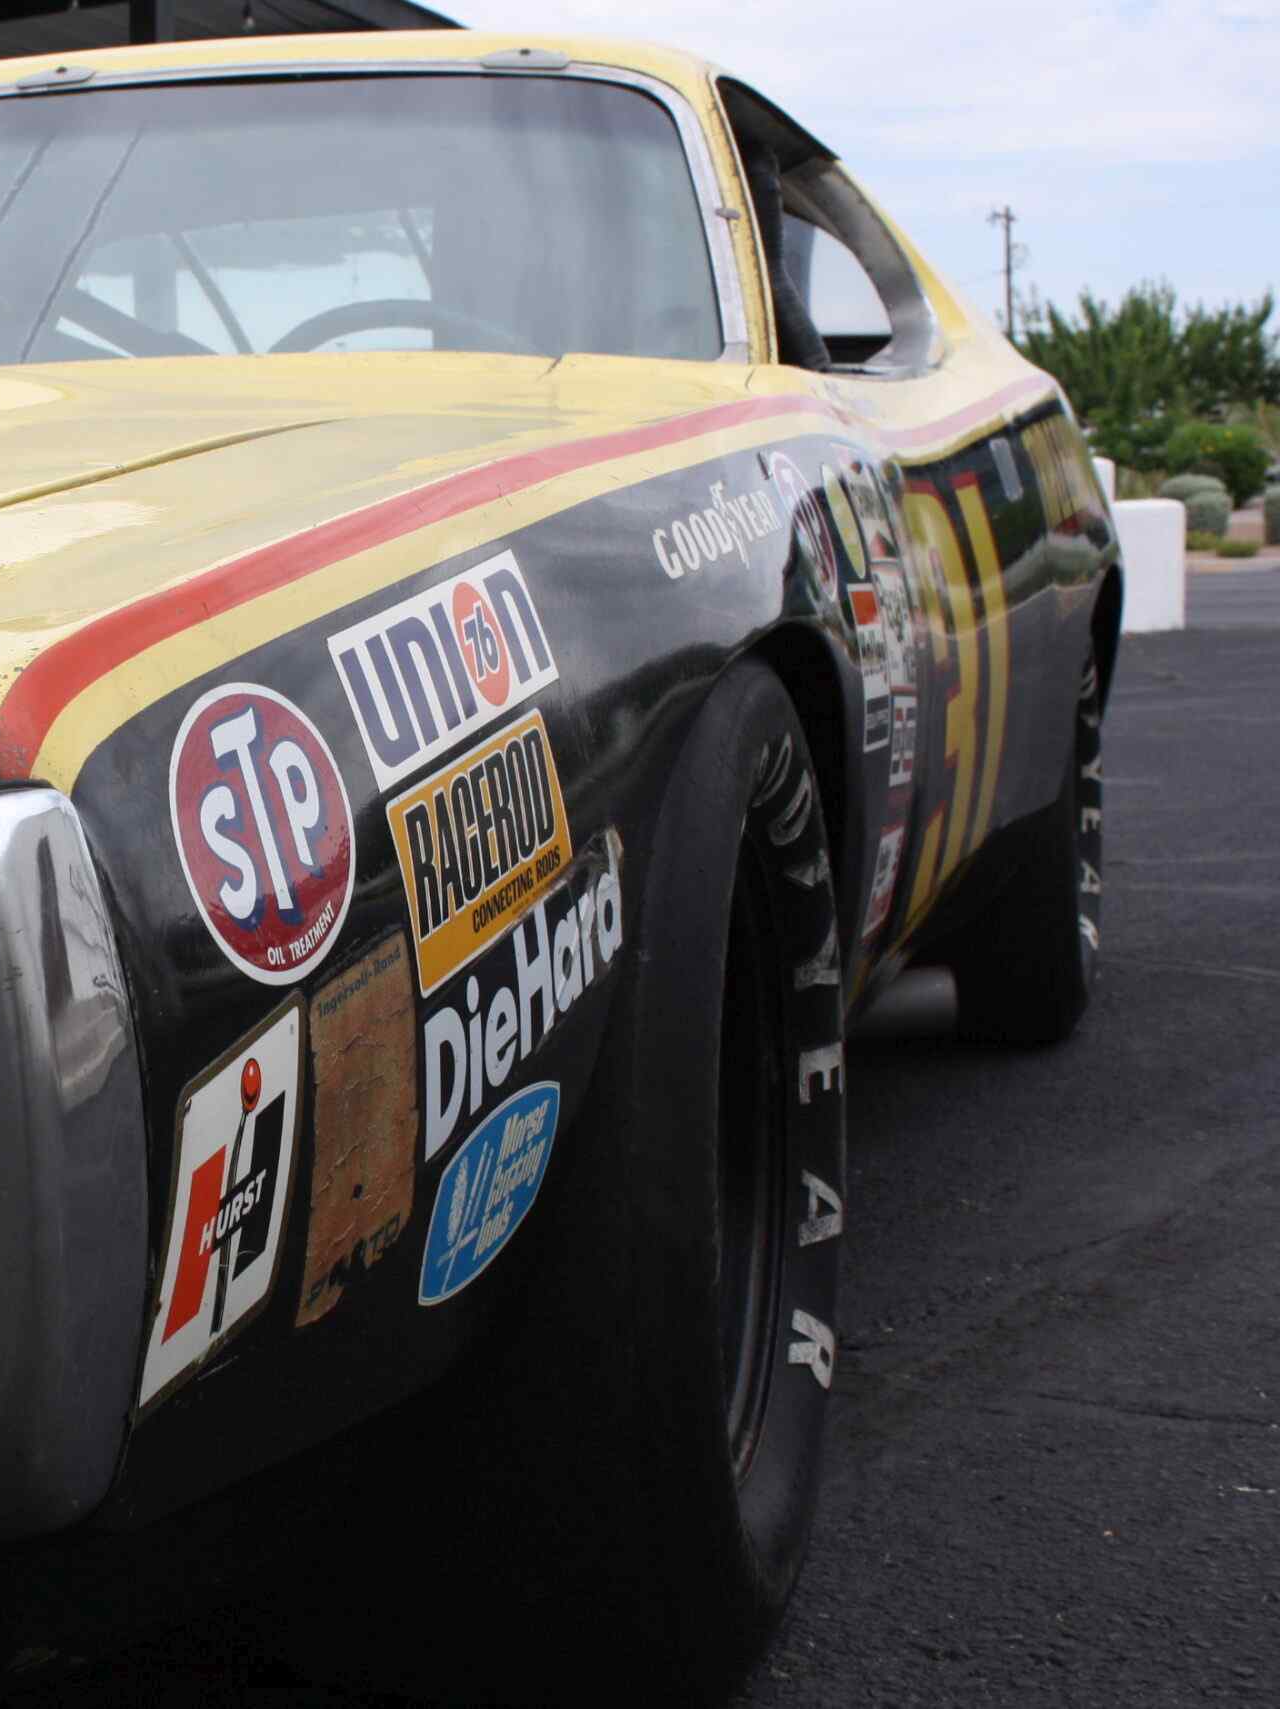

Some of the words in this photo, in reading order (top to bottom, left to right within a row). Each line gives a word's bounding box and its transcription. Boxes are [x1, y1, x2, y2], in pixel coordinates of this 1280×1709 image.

[652, 487, 780, 579] GOODYEAR
[461, 603, 500, 682] 76
[199, 707, 320, 921] STP
[404, 724, 556, 938] RACEROD
[267, 945, 287, 966] OIL
[288, 899, 336, 962] TREATMENT
[472, 866, 534, 933] CONNECTING
[535, 845, 561, 884] RODS
[424, 827, 622, 1163] DieHard
[198, 1168, 267, 1257] HURST
